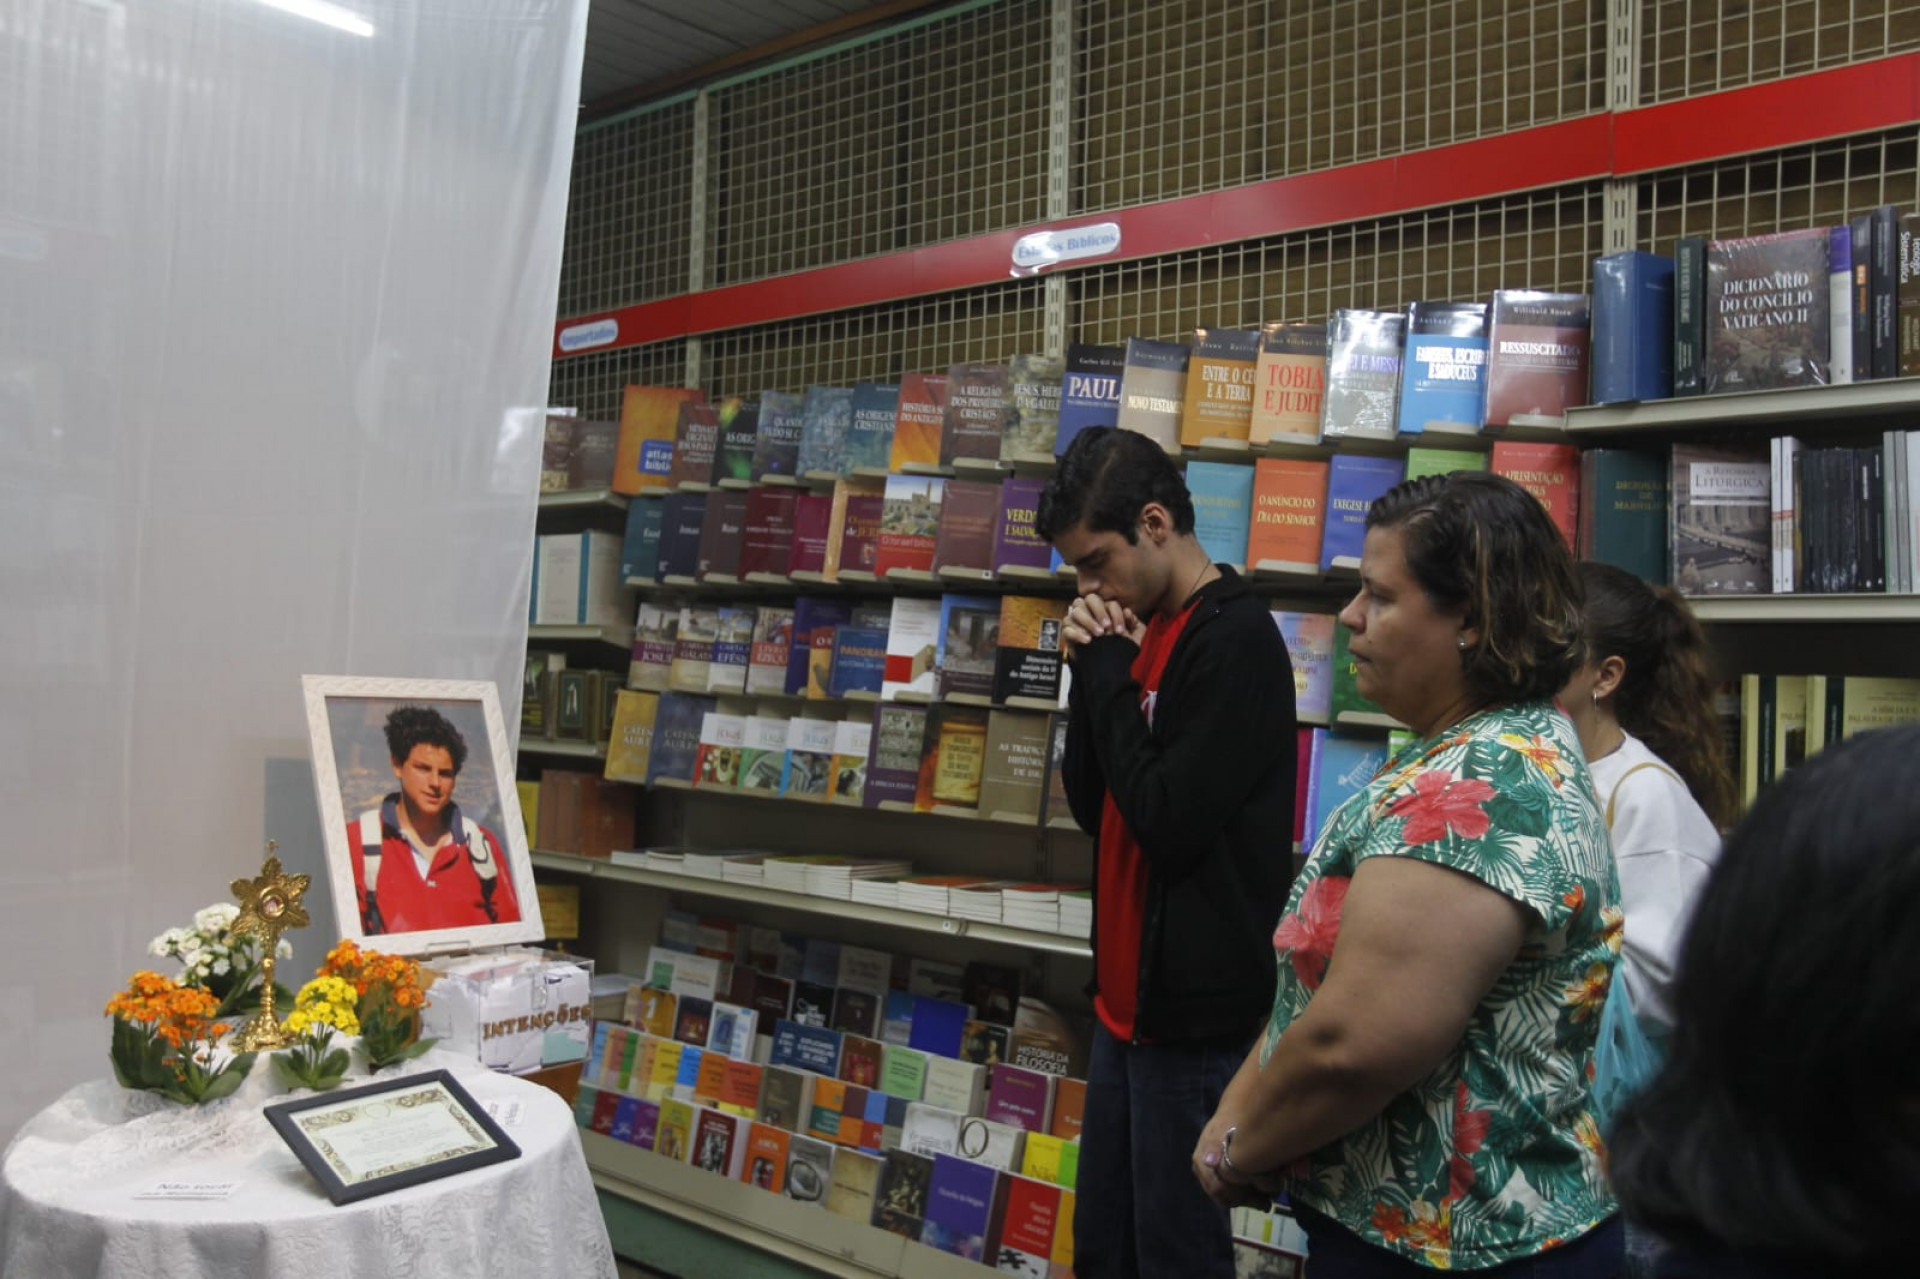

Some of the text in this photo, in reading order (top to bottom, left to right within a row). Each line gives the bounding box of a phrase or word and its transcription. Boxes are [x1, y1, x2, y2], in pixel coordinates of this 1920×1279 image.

[1723, 270, 1809, 295] DICIONÁRIO
[1719, 296, 1740, 313] DO
[1721, 307, 1808, 330] VATICANO II
[1202, 365, 1230, 383] ENTRE
[1067, 376, 1123, 402] PAUL
[1264, 390, 1274, 411] E
